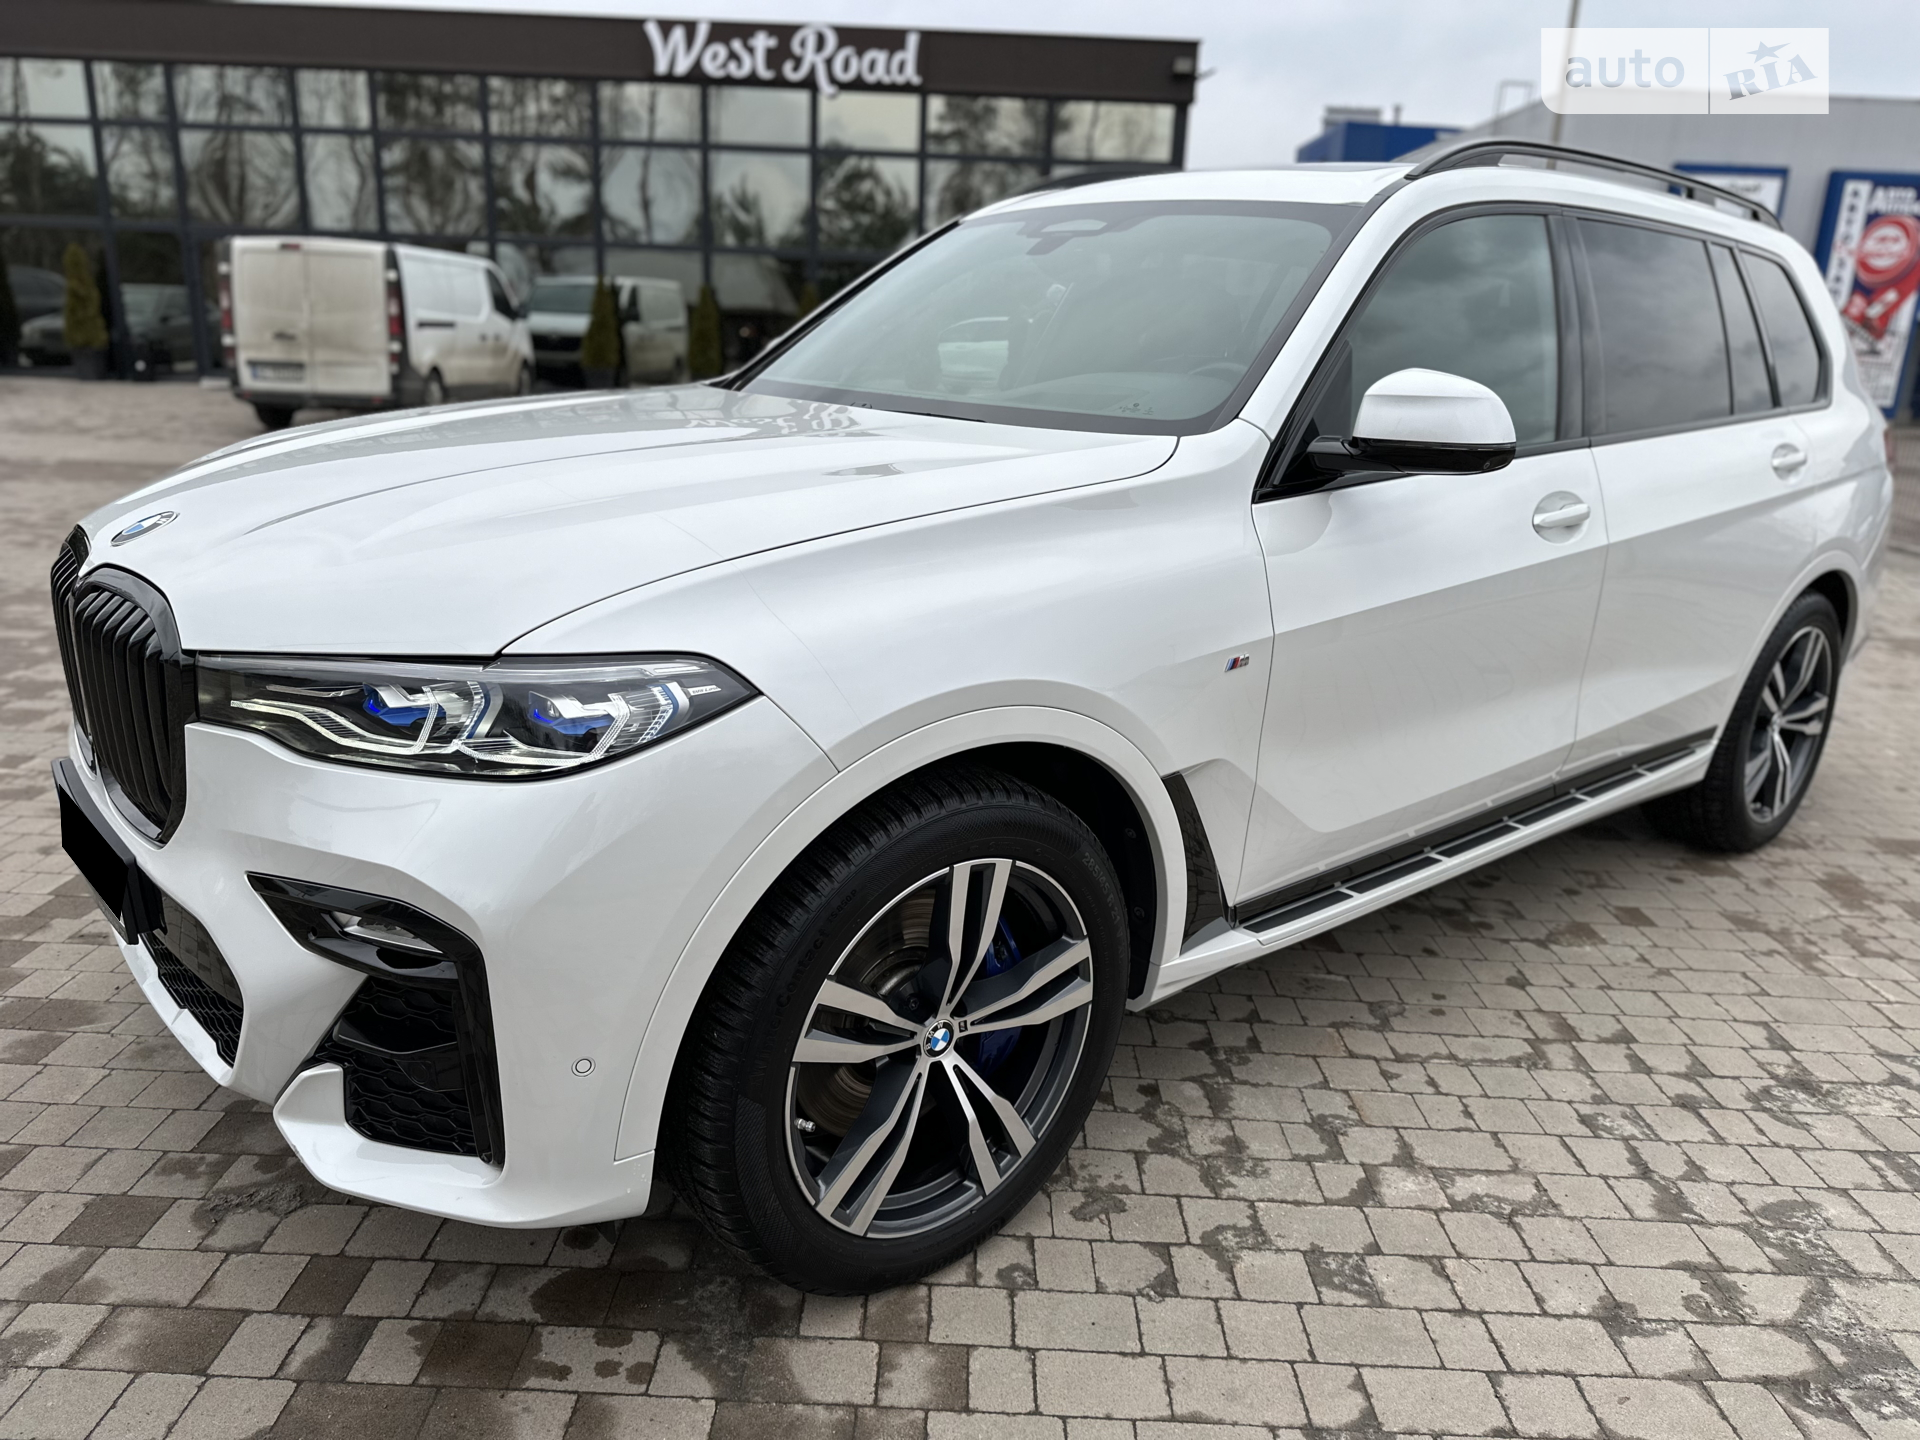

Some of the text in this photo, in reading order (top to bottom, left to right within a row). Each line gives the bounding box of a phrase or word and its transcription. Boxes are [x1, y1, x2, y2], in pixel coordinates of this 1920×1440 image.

[643, 19, 923, 99] West Road
[1082, 852, 1110, 895] 285/45
